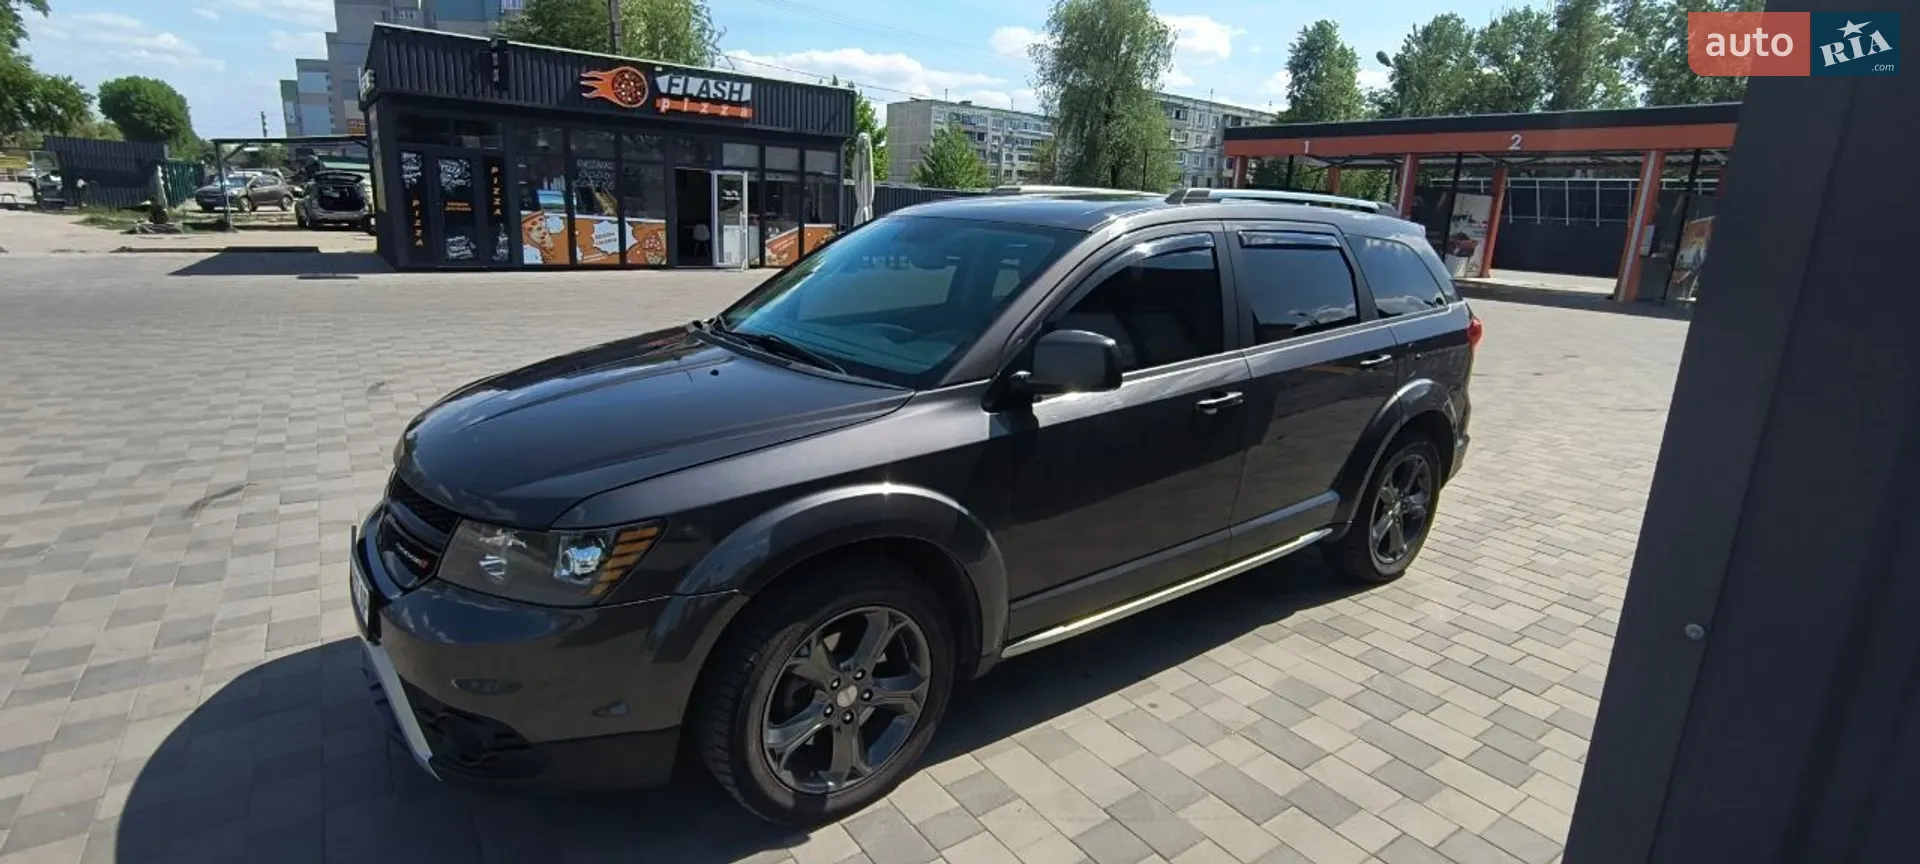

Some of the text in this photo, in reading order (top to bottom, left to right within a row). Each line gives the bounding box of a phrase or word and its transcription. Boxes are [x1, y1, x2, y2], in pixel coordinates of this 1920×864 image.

[667, 74, 745, 101] FLASH
[659, 98, 749, 118] pizza
[1303, 139, 1311, 154] 1
[1510, 134, 1523, 151] 2
[490, 166, 502, 215] PIZZA
[412, 199, 424, 248] PIZZA
